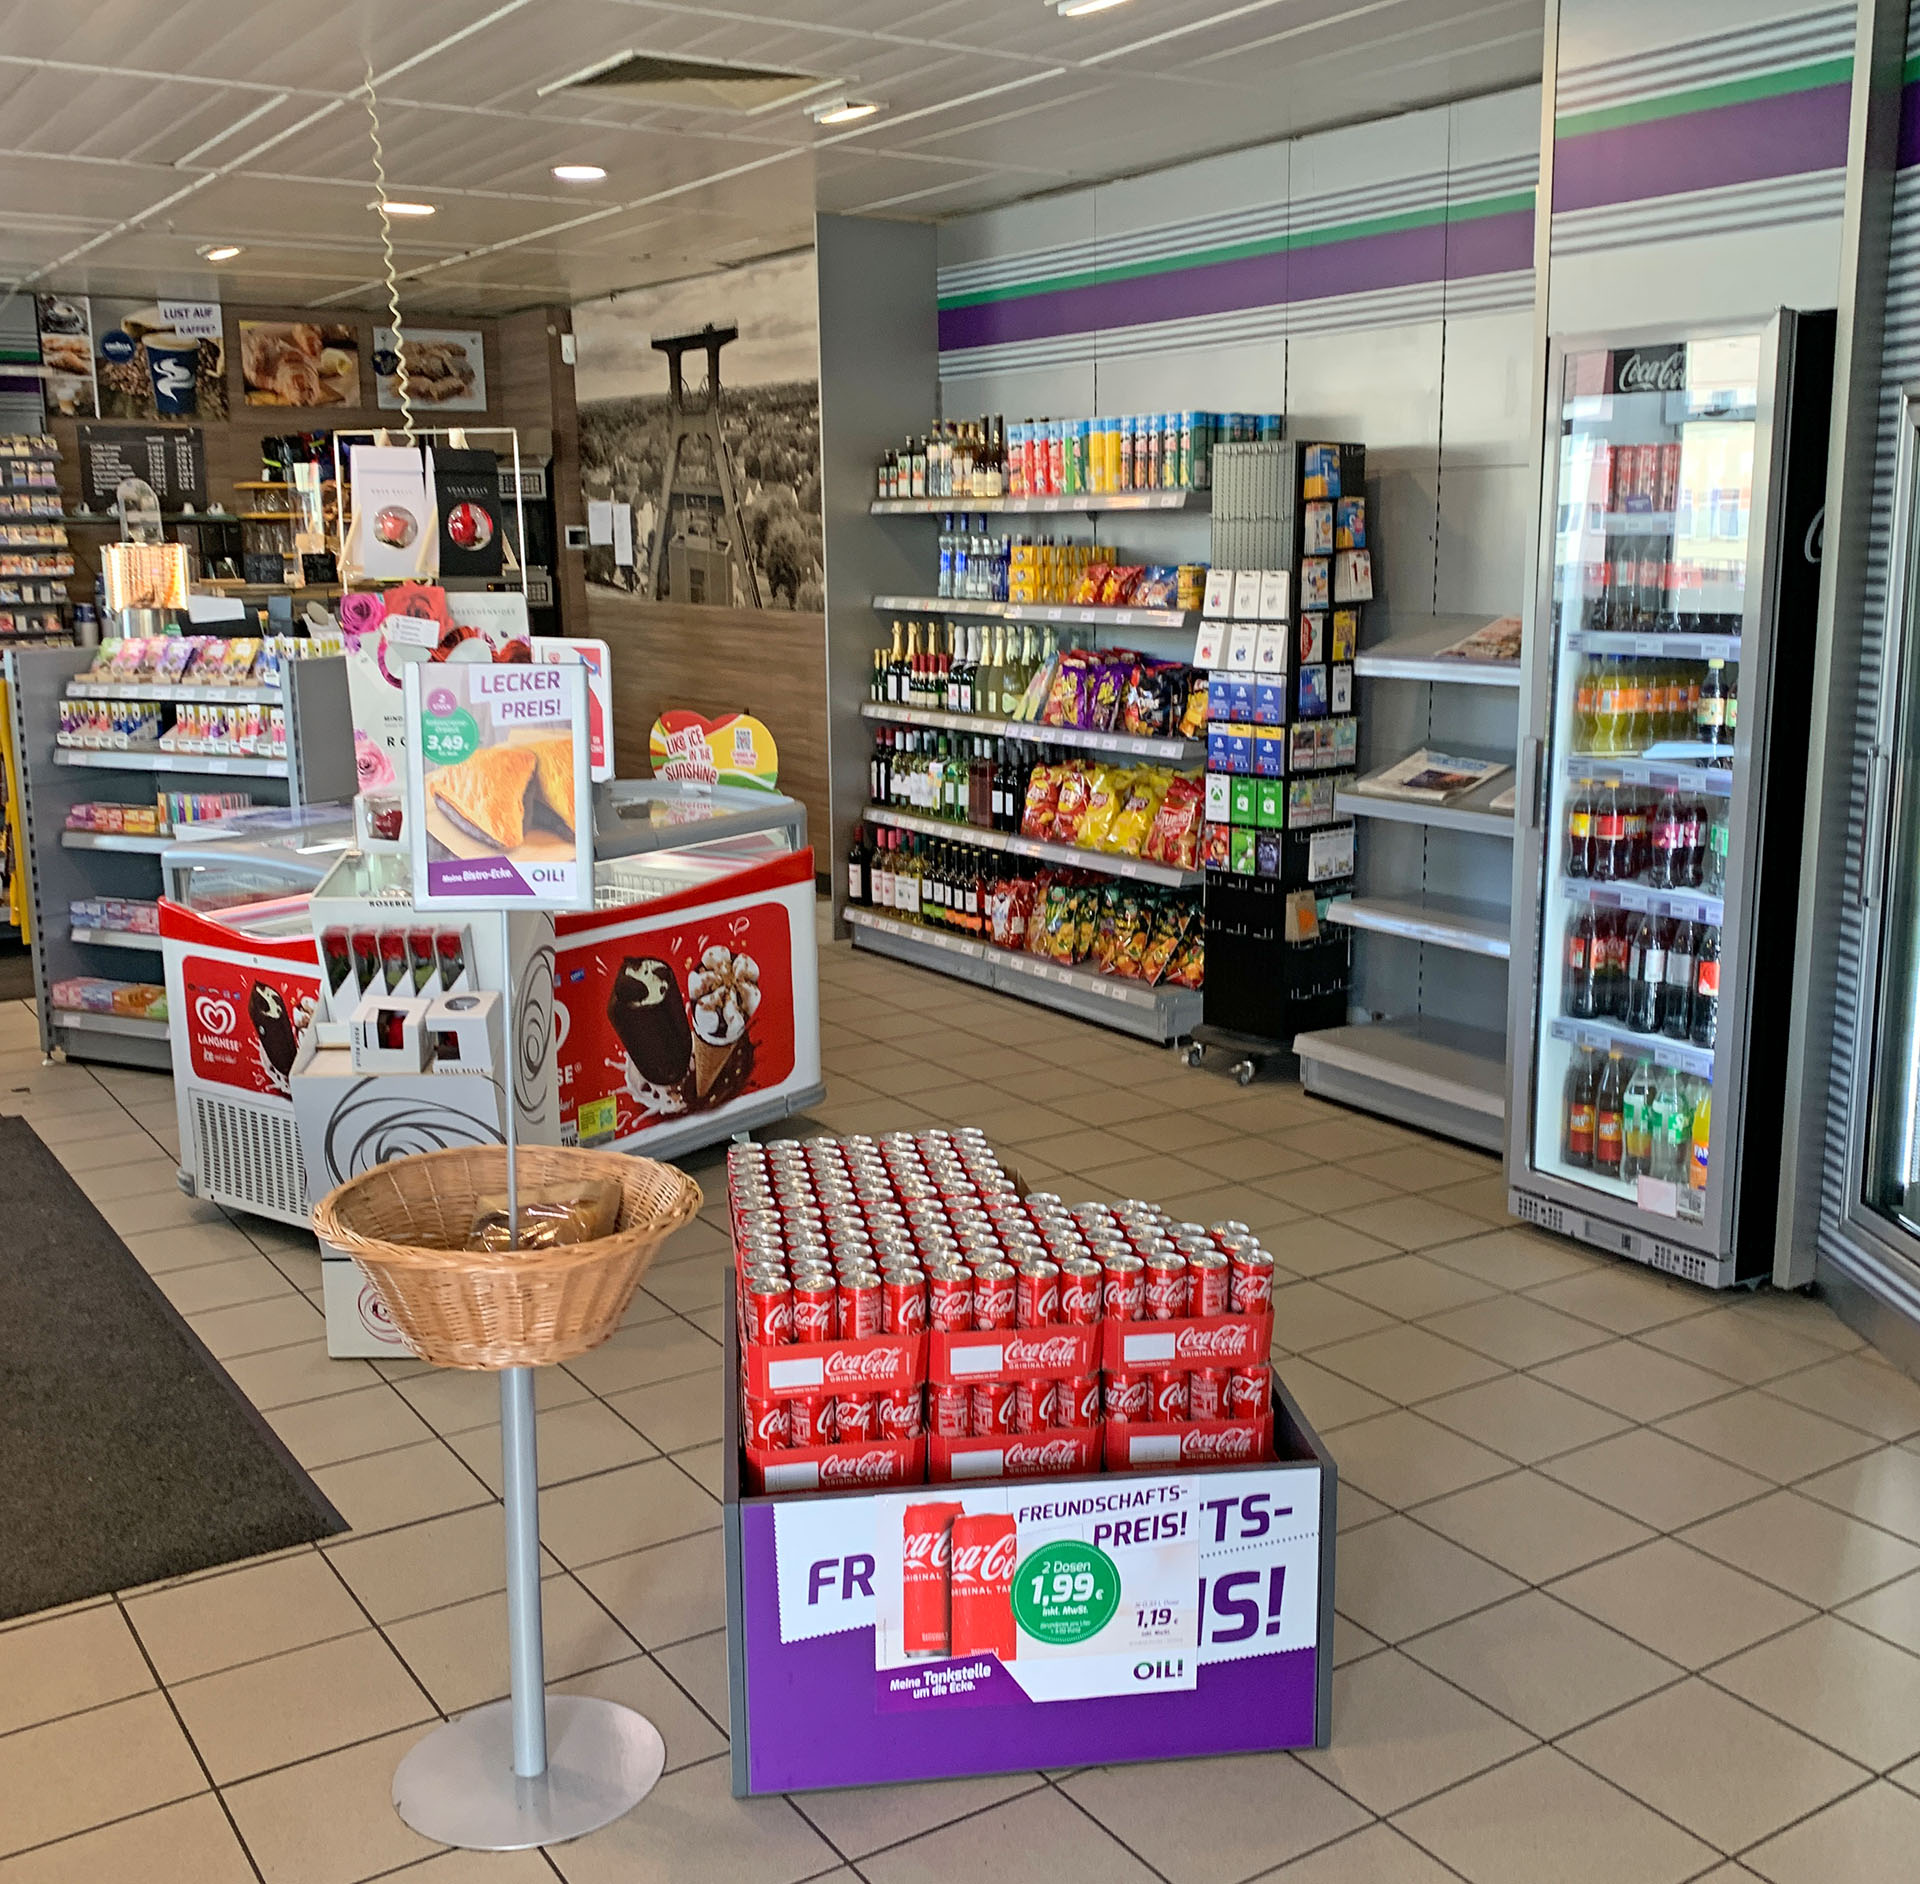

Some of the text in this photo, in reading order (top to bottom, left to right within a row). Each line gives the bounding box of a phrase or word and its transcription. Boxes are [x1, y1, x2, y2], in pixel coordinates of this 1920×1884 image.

[163, 307, 213, 319] LUST AUF
[480, 671, 561, 694] LECKER
[501, 699, 561, 719] PREIS!
[532, 869, 565, 882] OIL!
[197, 1032, 240, 1053] LANGNESE
[1176, 1324, 1250, 1352] Coca-Cola
[1004, 1336, 1080, 1364] Coca-Cola
[1180, 1348, 1242, 1358] ORIGINAL TASTE
[824, 1347, 903, 1377] Coca-Cola
[1008, 1360, 1072, 1370] ORIGINAL TASTE
[829, 1372, 895, 1383] ORIGINAL TASTE
[1181, 1427, 1256, 1455] Coca-Cola
[820, 1449, 897, 1480] Coca-Cola
[1004, 1439, 1080, 1468] Coca-Cola
[1018, 1484, 1188, 1524] FREUNDSCHAFTS-
[1093, 1511, 1188, 1547] PREIS!
[1200, 1493, 1293, 1543] TS-
[1041, 1560, 1091, 1574] 2 Dosen
[890, 1662, 992, 1692] Meine Tankstelle
[1133, 1658, 1184, 1680] OIL!
[913, 1680, 976, 1699] um die Ecke.
